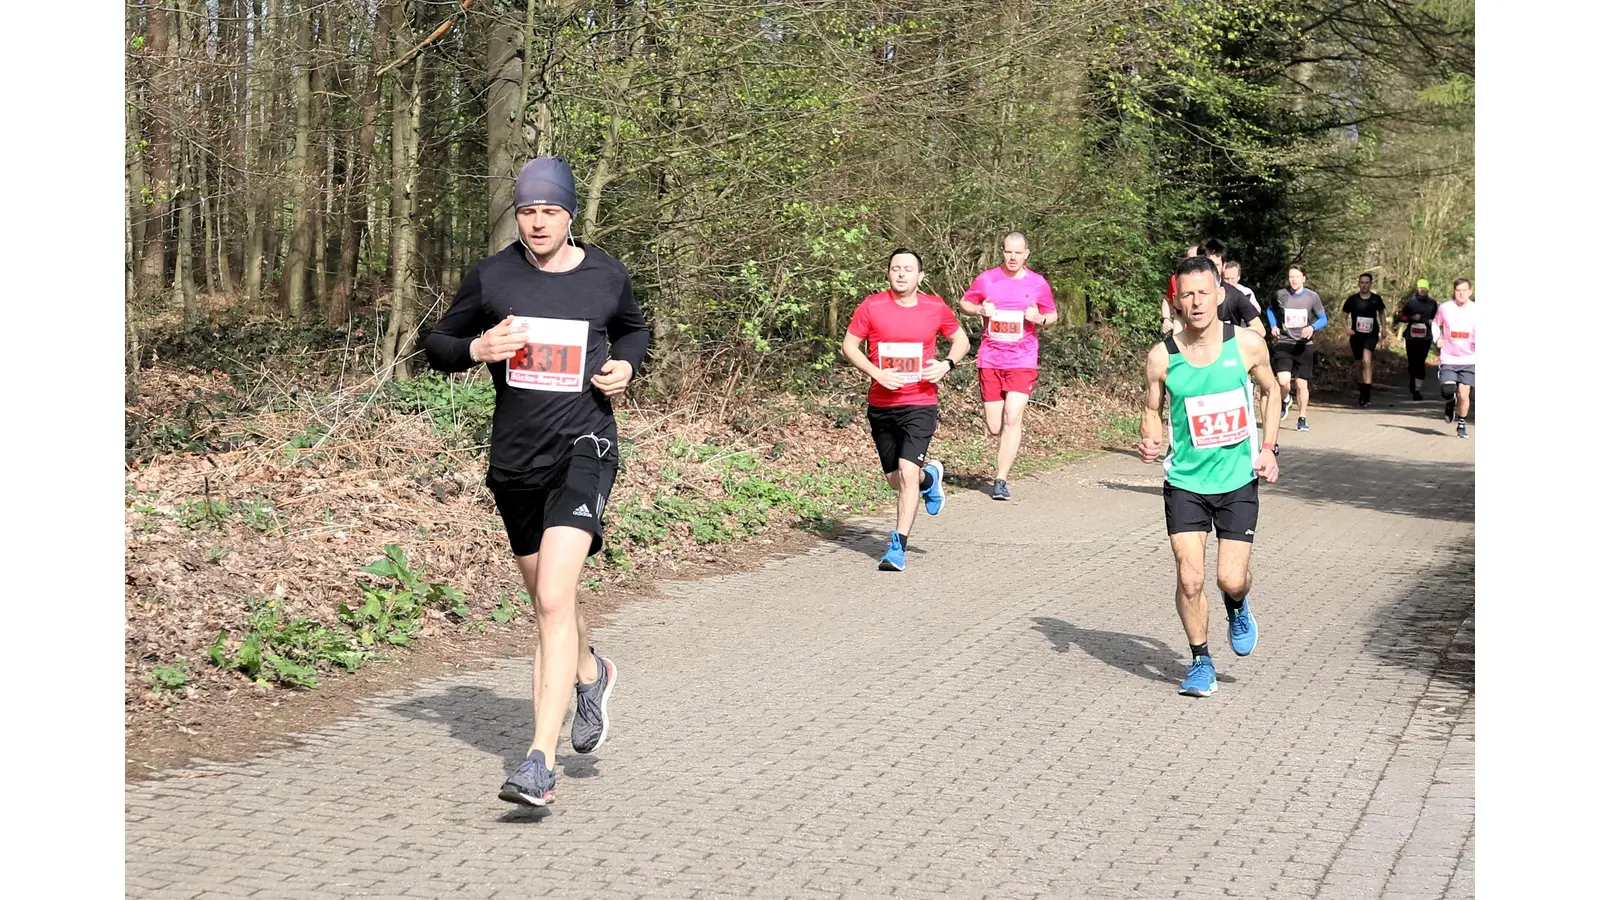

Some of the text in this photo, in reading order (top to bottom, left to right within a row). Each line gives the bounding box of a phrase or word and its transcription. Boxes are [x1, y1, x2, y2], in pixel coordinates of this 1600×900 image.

[993, 321, 1017, 334] 339
[518, 343, 569, 372] 331
[884, 357, 916, 373] 330
[1198, 409, 1241, 436] 347
[572, 510, 593, 518] adidas
